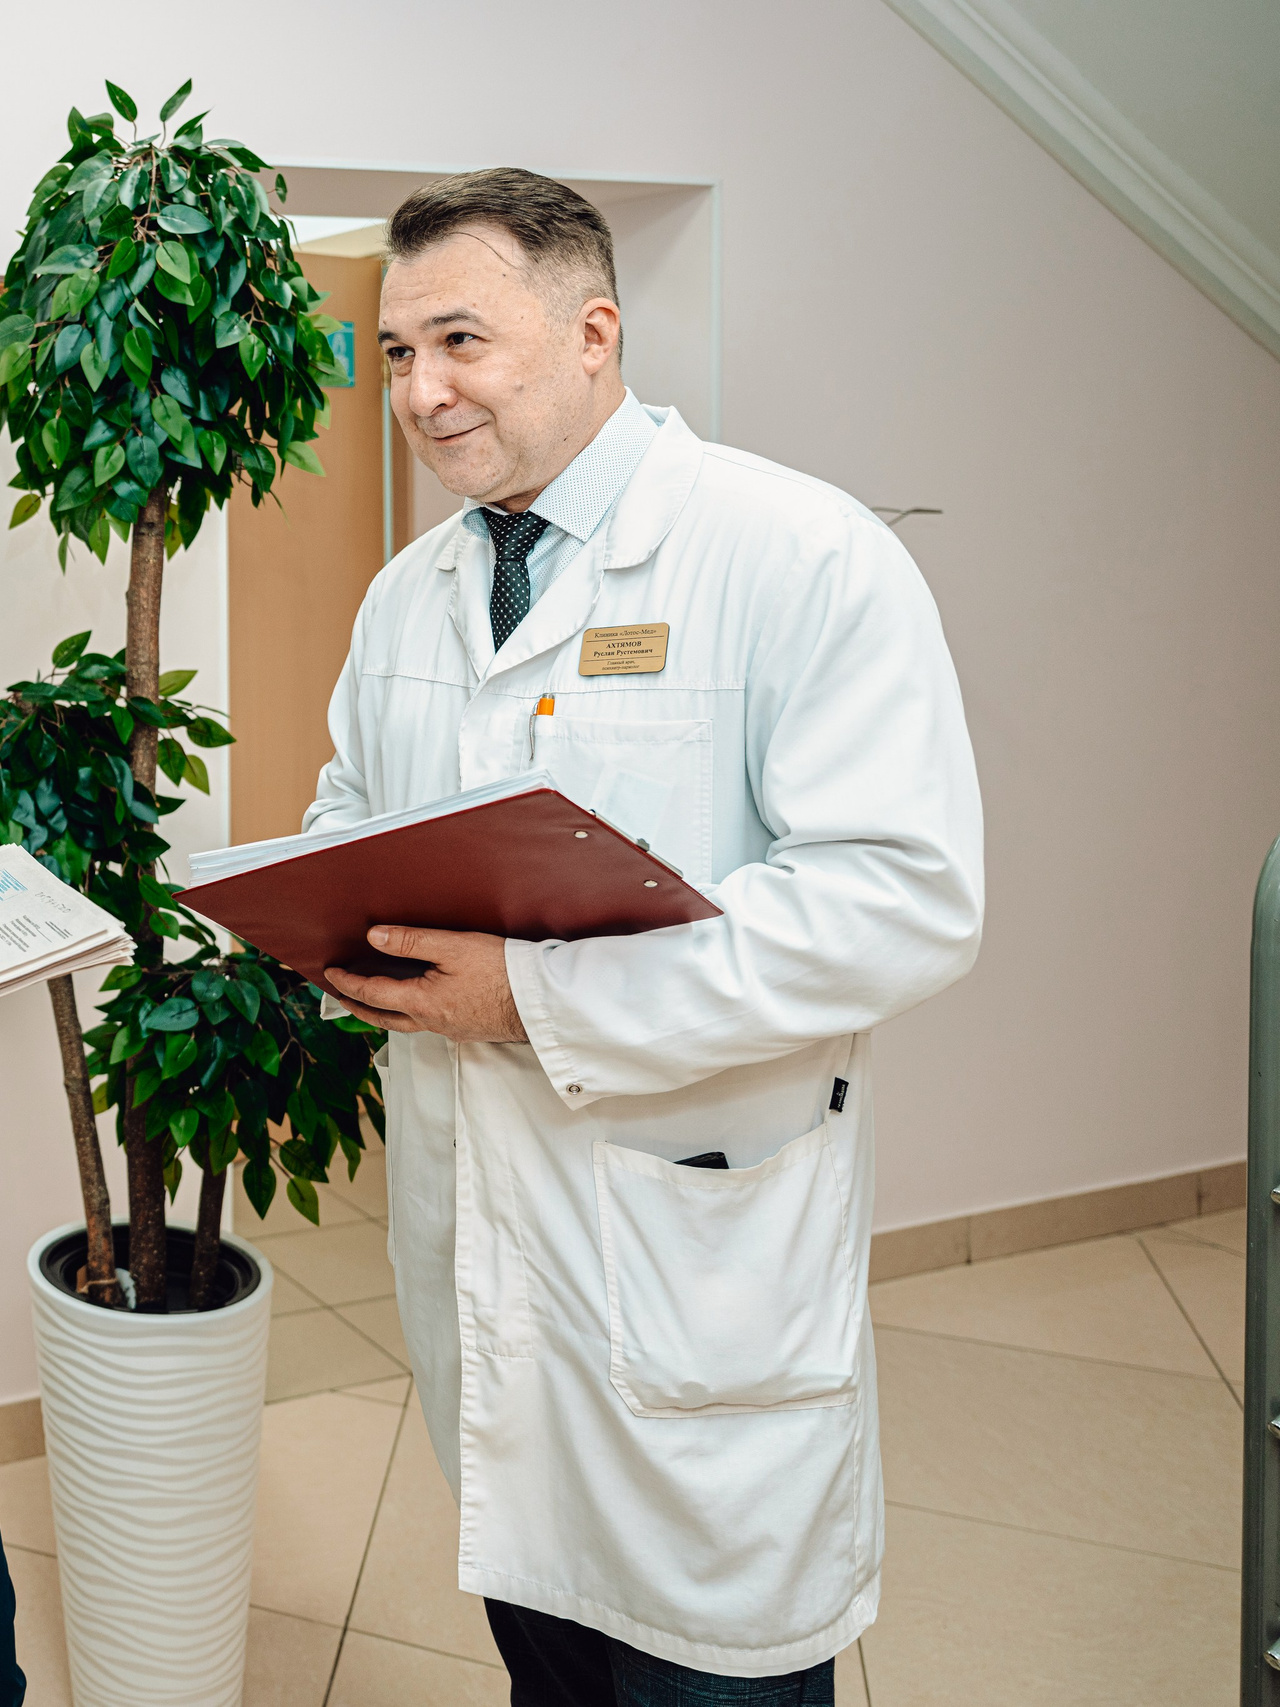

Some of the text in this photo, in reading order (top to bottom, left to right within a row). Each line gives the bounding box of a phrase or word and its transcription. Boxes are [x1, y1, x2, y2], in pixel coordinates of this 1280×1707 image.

[619, 628, 657, 636] «Лотос-Мед»
[606, 641, 642, 649] АХТЯМОВ
[593, 650, 615, 658] Руслан
